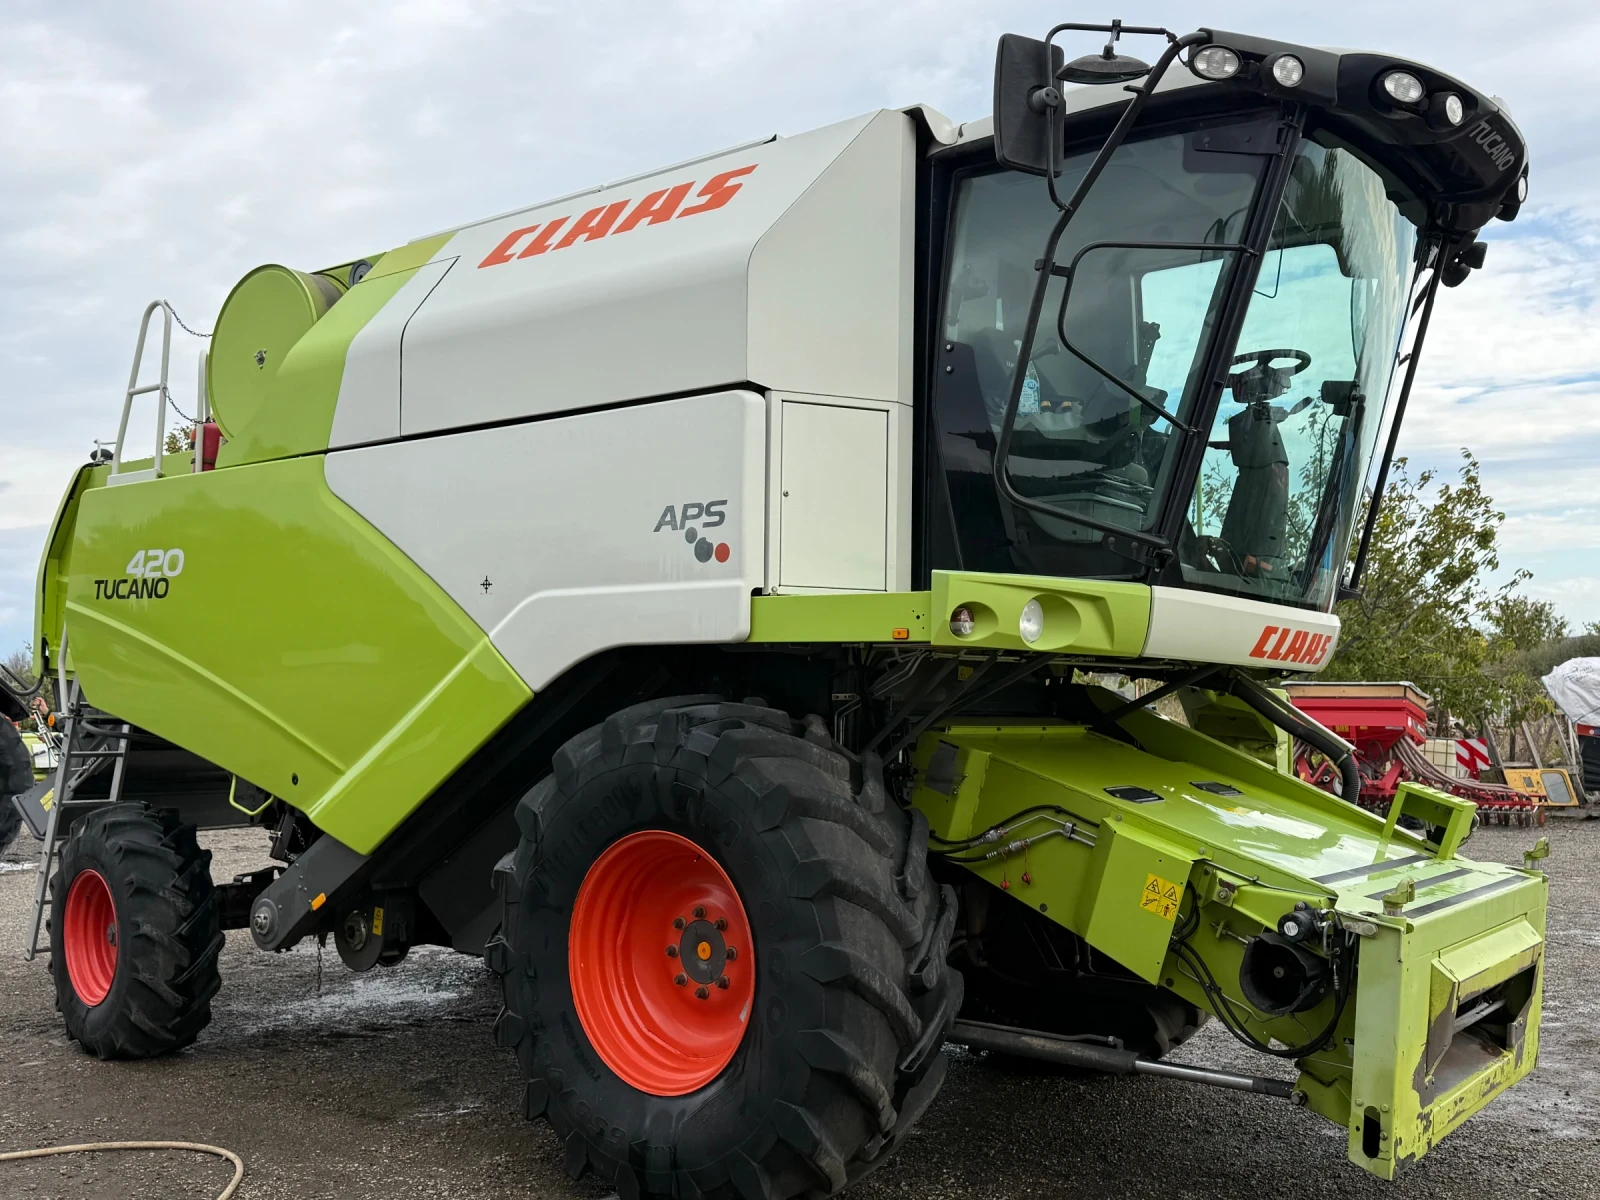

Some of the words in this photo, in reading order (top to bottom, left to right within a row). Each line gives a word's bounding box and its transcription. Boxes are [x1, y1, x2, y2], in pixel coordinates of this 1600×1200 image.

[1469, 121, 1515, 171] TUCANO
[477, 164, 759, 269] CLAAS
[653, 499, 728, 532] APS
[126, 548, 185, 578] 420
[94, 577, 169, 600] TUCANO
[1249, 625, 1332, 665] CLAAS
